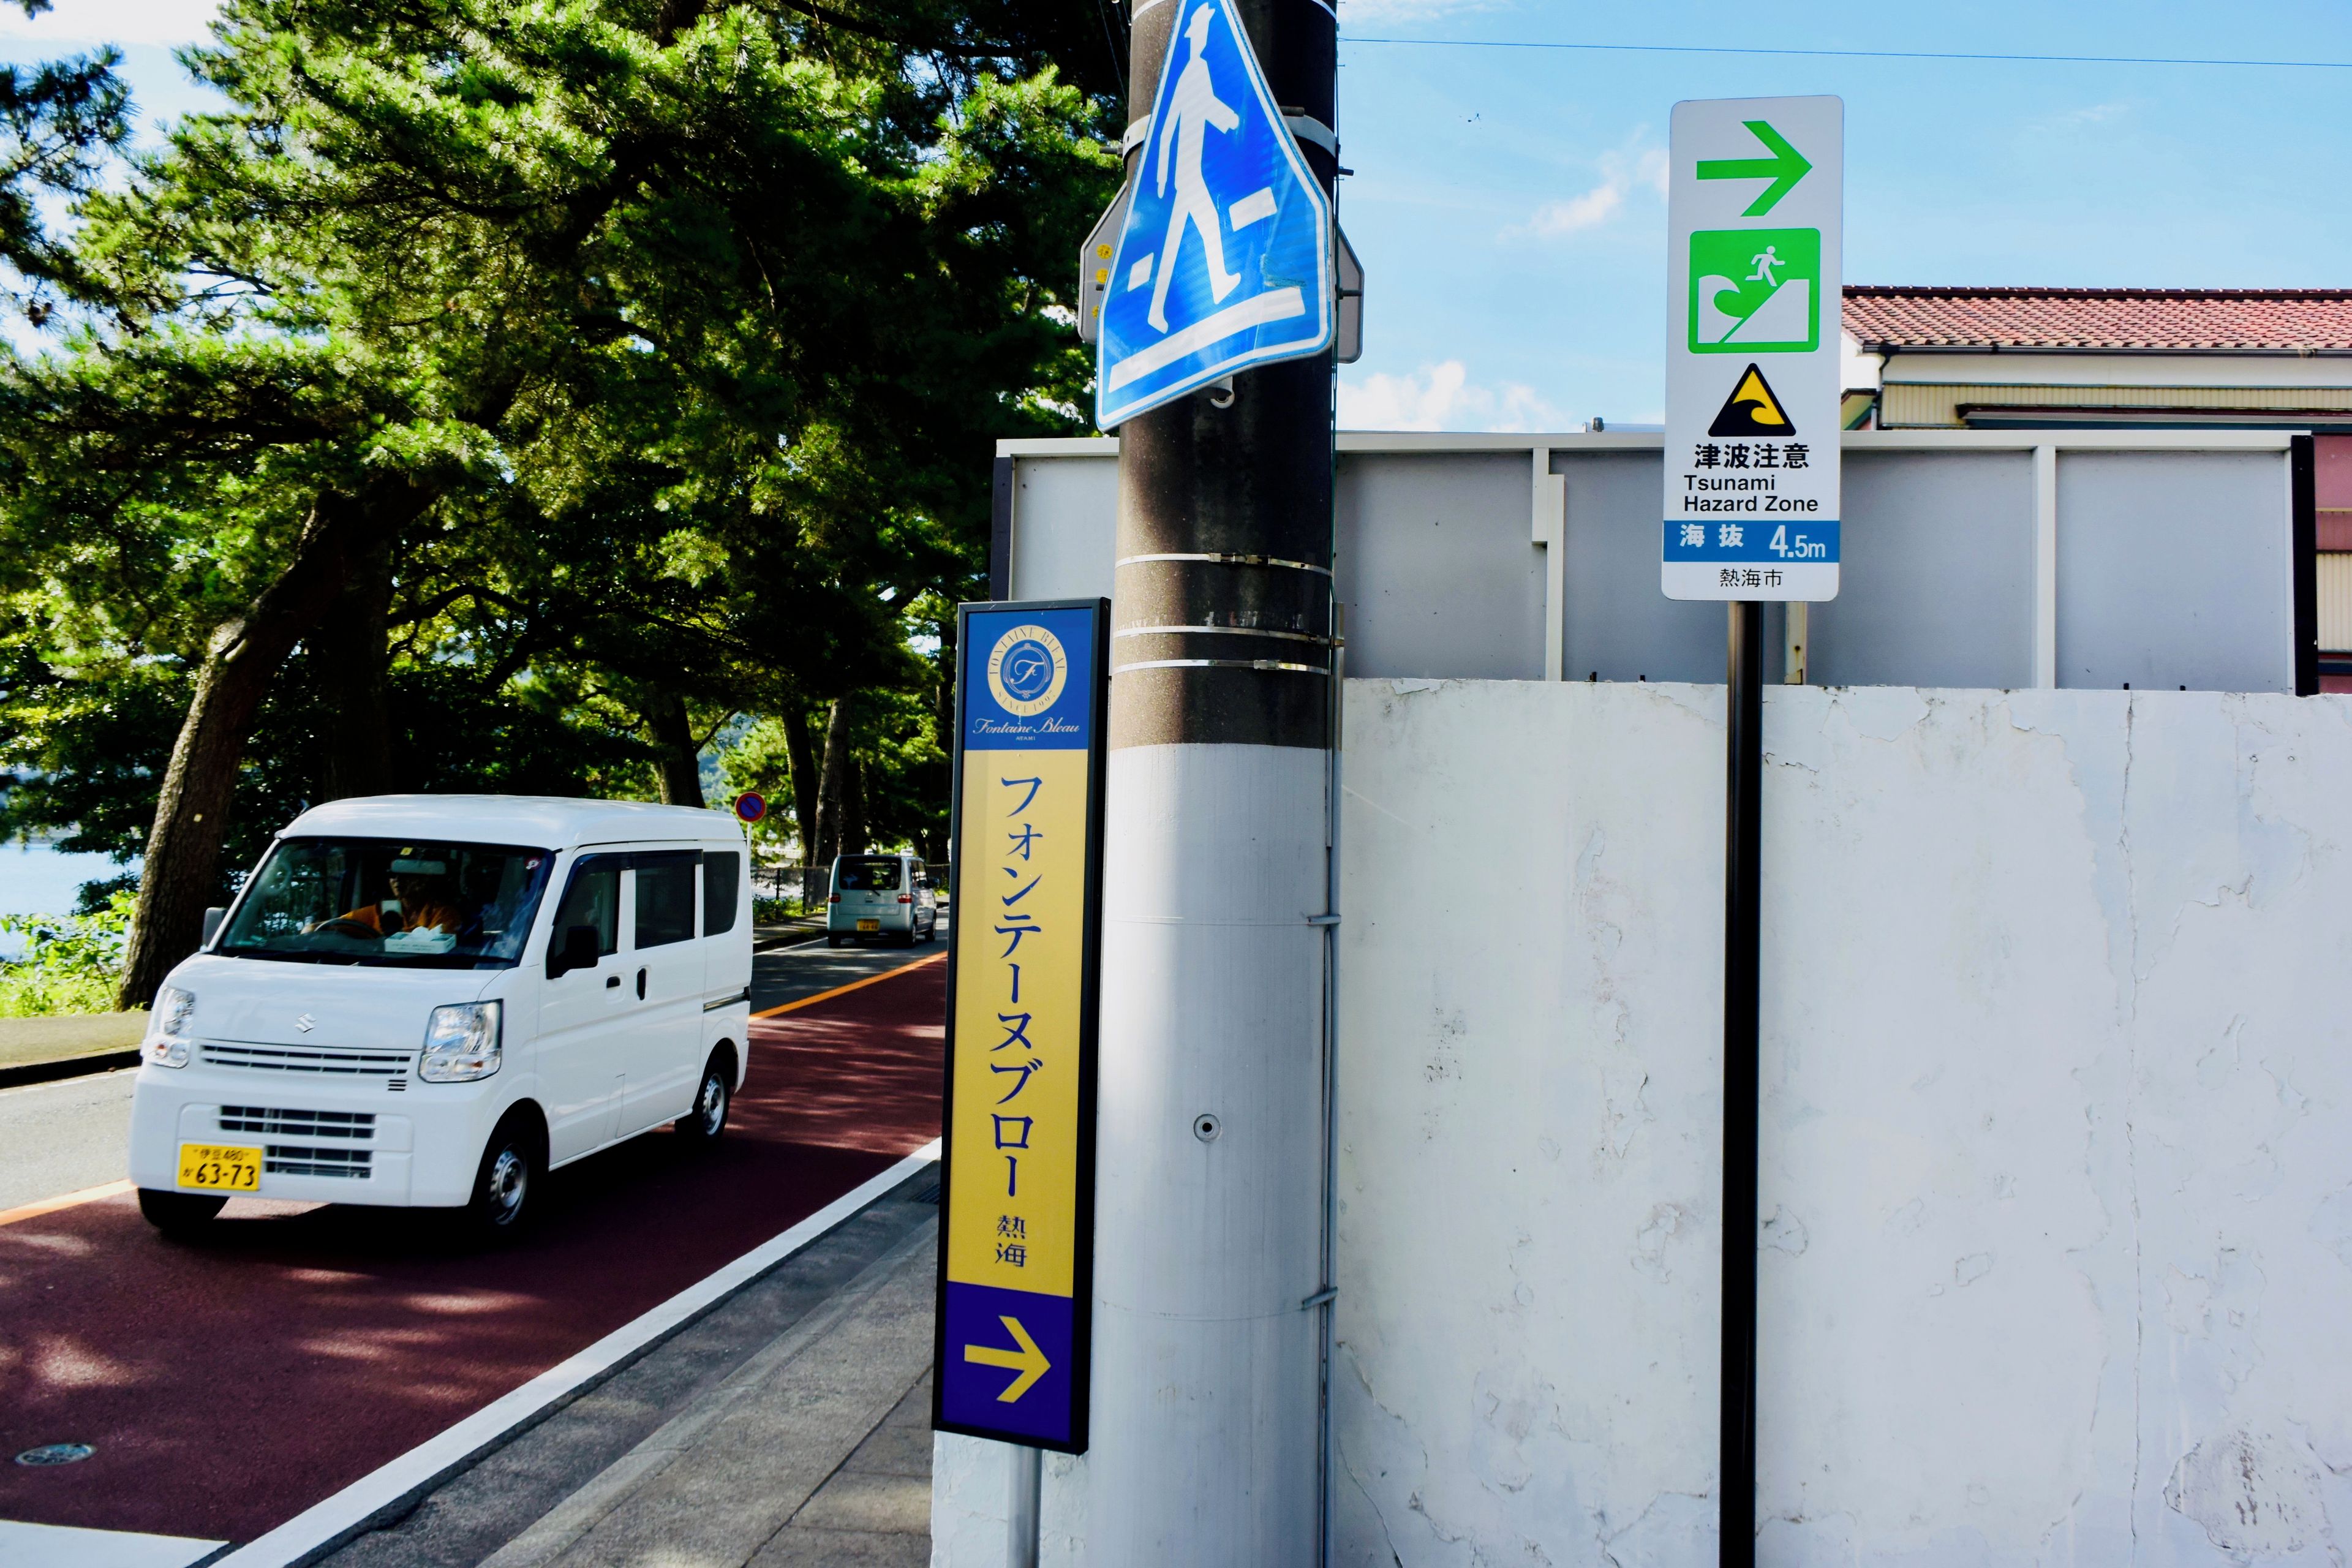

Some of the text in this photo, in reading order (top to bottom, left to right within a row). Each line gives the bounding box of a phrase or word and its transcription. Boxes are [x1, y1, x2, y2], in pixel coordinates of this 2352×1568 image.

[1694, 443, 1810, 469] 津波注意
[1684, 475, 1774, 491] Tsunami
[1684, 496, 1819, 511] Hazard Zone
[1769, 525, 1826, 558] 4.5m
[1719, 568, 1783, 587] 熱海市
[1033, 717, 1080, 733] Bleau
[989, 777, 1043, 1267] フォンテーヌブロー 熱海
[196, 1163, 255, 1186] 63-73
